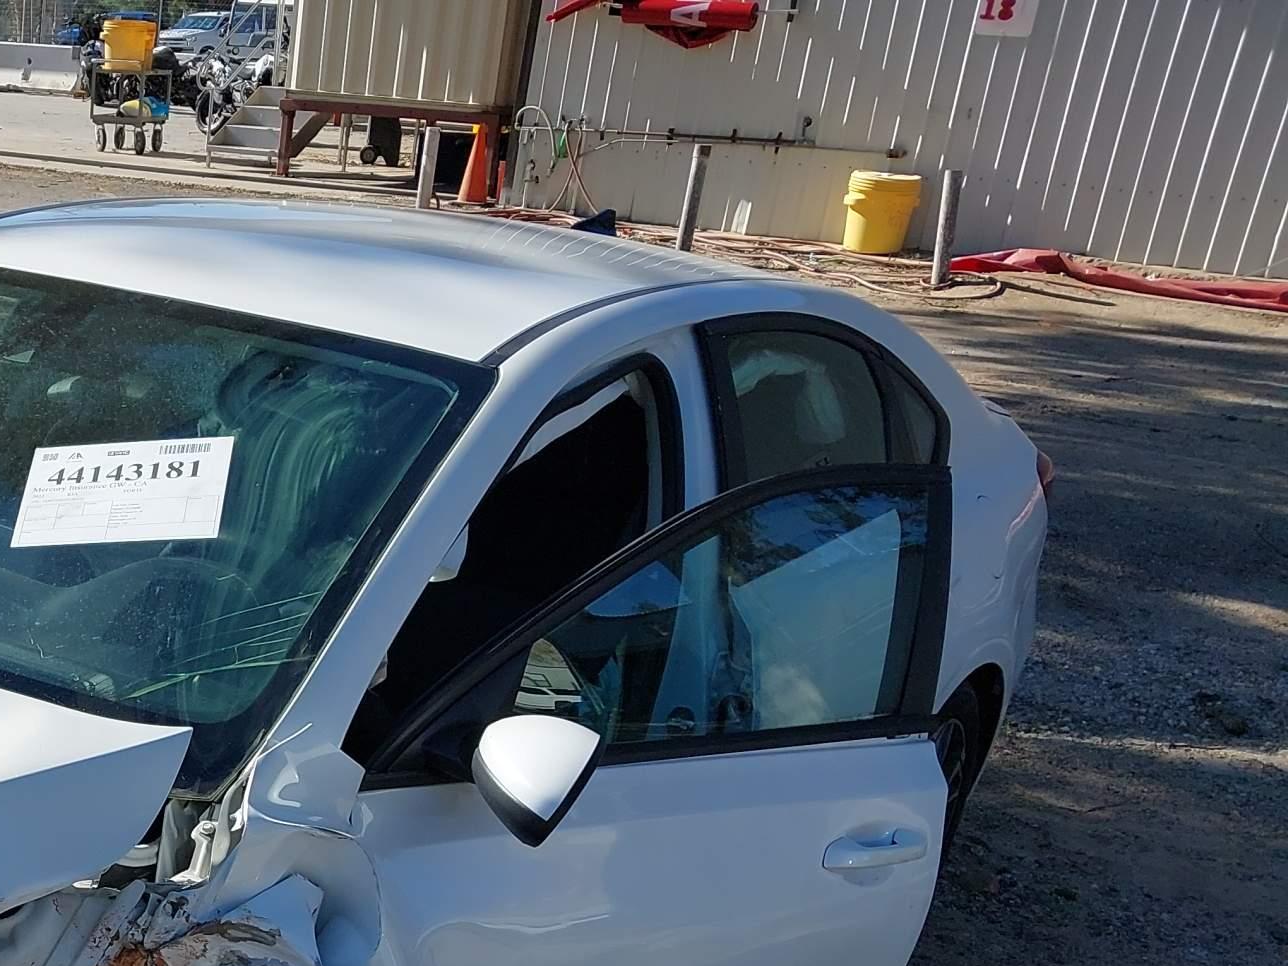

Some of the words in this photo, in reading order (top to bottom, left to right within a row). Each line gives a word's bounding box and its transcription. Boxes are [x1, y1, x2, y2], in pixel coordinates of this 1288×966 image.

[48, 460, 201, 486] 44143181
[33, 486, 67, 494] Mercury
[69, 484, 108, 493] Insurance
